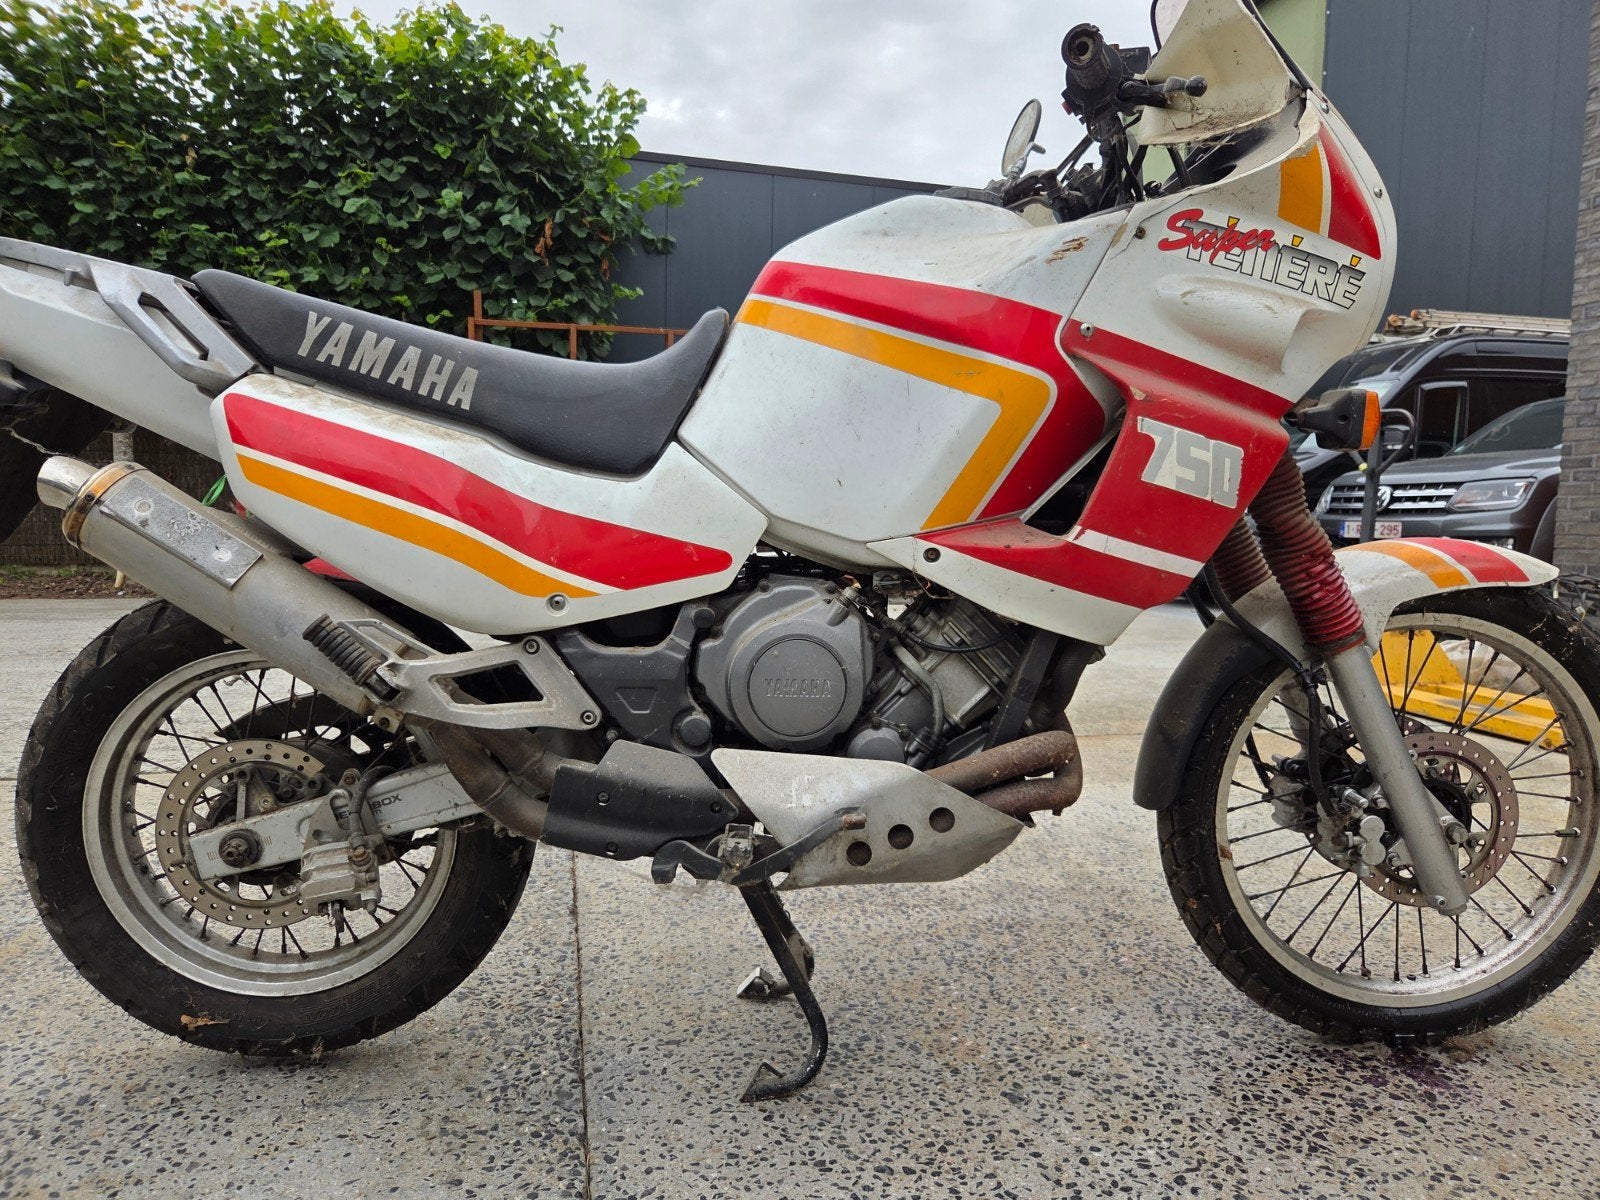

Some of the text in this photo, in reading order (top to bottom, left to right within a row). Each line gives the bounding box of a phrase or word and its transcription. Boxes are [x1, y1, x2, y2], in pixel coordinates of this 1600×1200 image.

[1157, 208, 1277, 263] Super
[297, 311, 479, 411] YAMAHA
[1137, 416, 1245, 509] 750
[764, 678, 832, 698] YAMAHA
